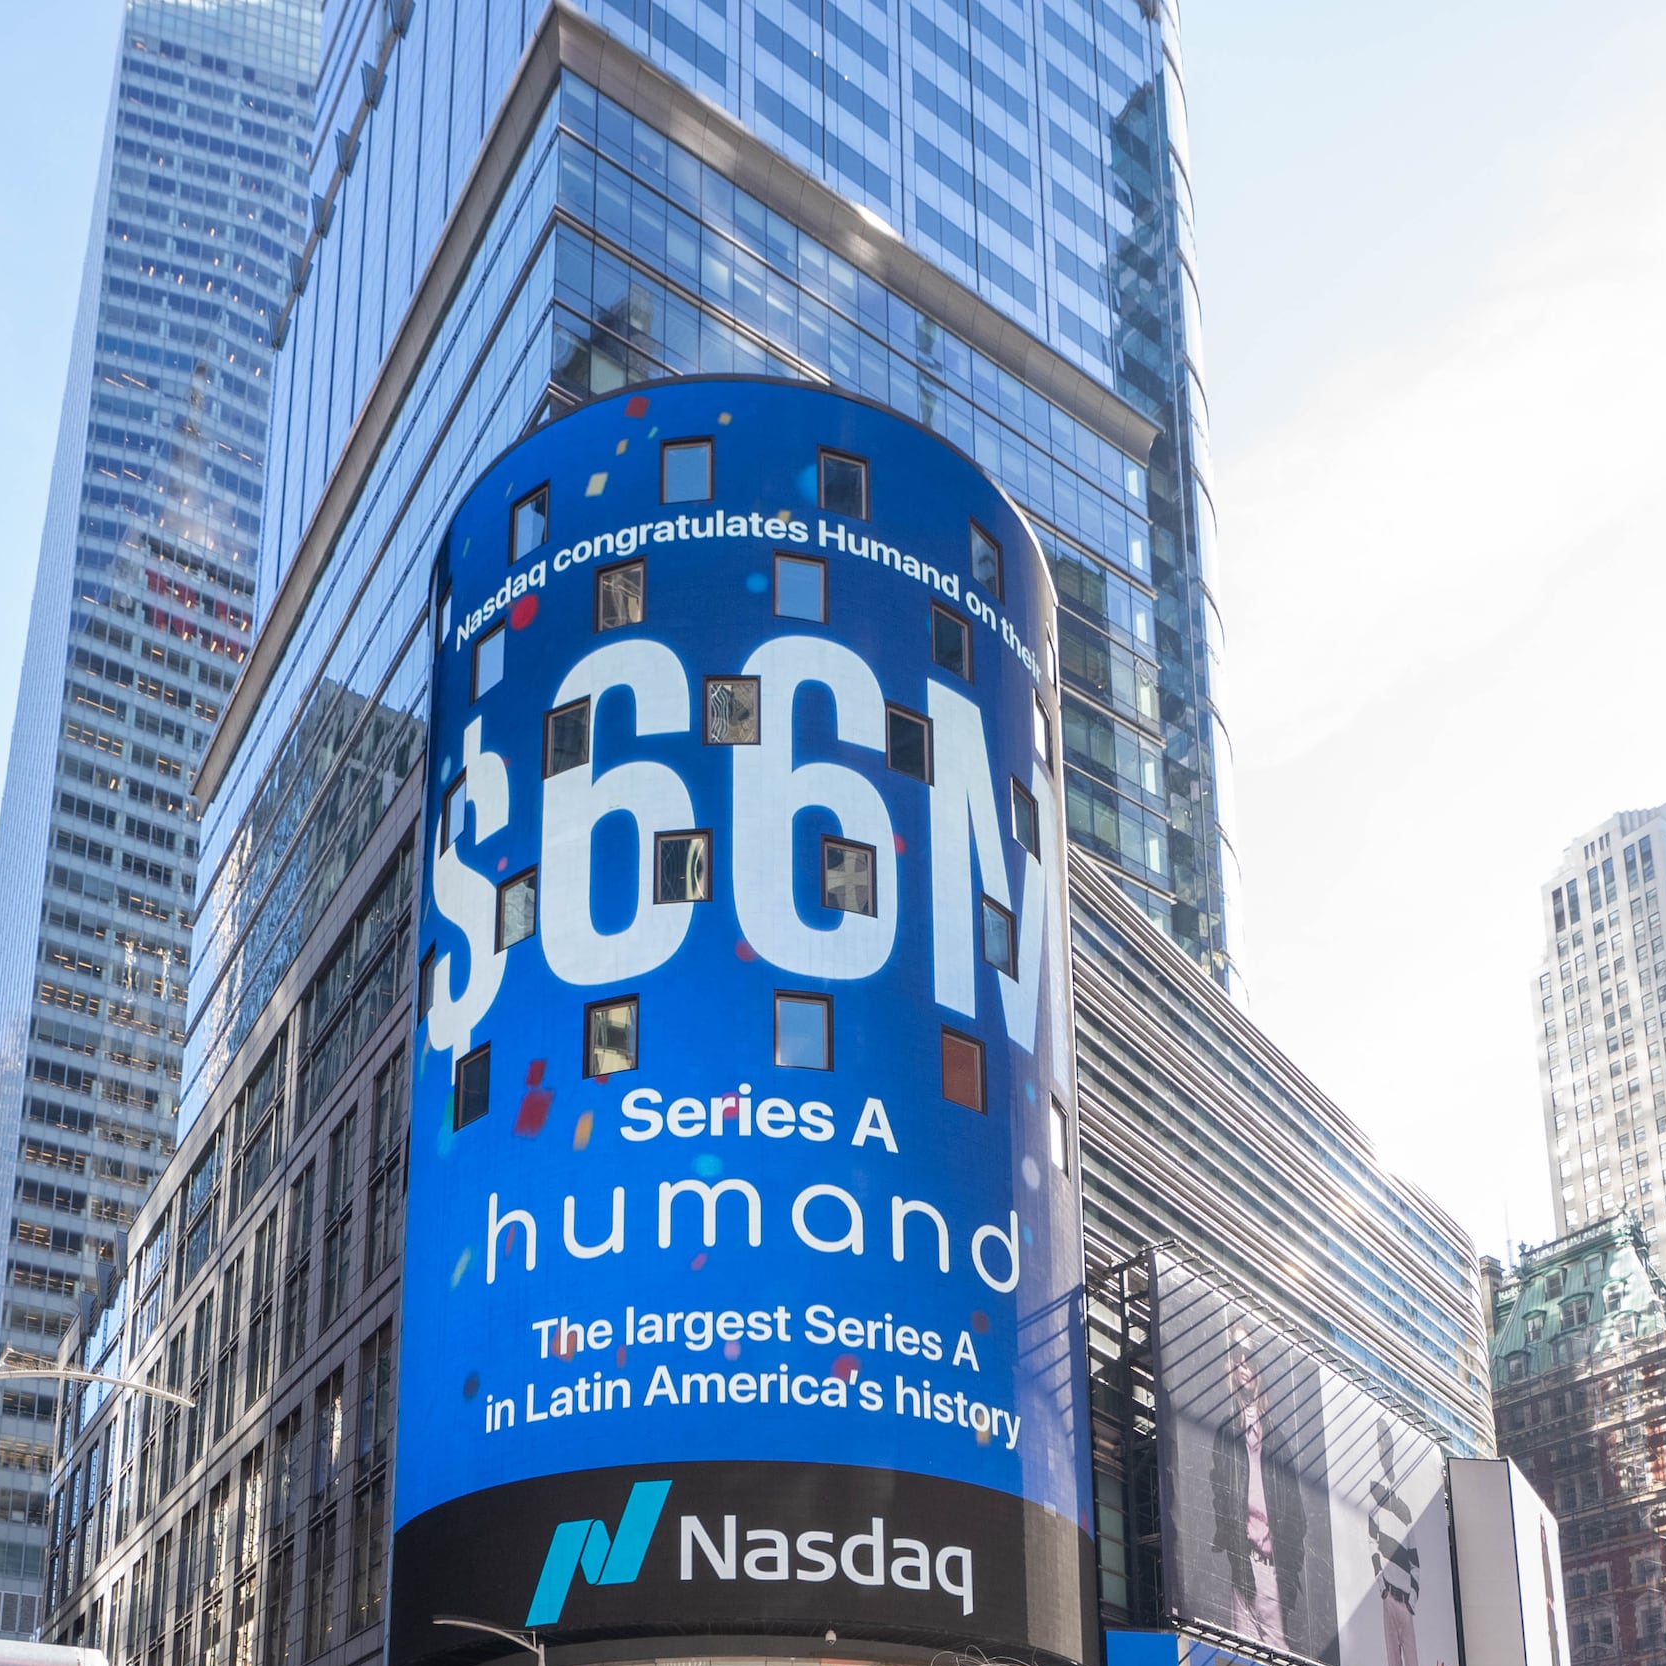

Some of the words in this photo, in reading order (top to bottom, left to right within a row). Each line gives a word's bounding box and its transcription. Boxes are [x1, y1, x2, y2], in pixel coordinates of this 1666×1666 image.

[455, 558, 546, 652] Nasdaq
[553, 509, 809, 573] congratulates
[819, 519, 960, 602] Humand
[965, 590, 998, 632] on
[1000, 610, 1042, 685] their
[425, 634, 1054, 1086] $66M
[621, 1083, 835, 1142] Series
[851, 1098, 899, 1153] A
[486, 1179, 1019, 1294] humand
[532, 1314, 613, 1361] The
[626, 1304, 790, 1352] largest
[804, 1304, 943, 1361] Series
[952, 1330, 980, 1372] A
[485, 1392, 515, 1433] in
[526, 1371, 631, 1424] Latin
[644, 1364, 884, 1413] America's
[896, 1374, 1021, 1449] history
[680, 1515, 975, 1616] Nasdaq
